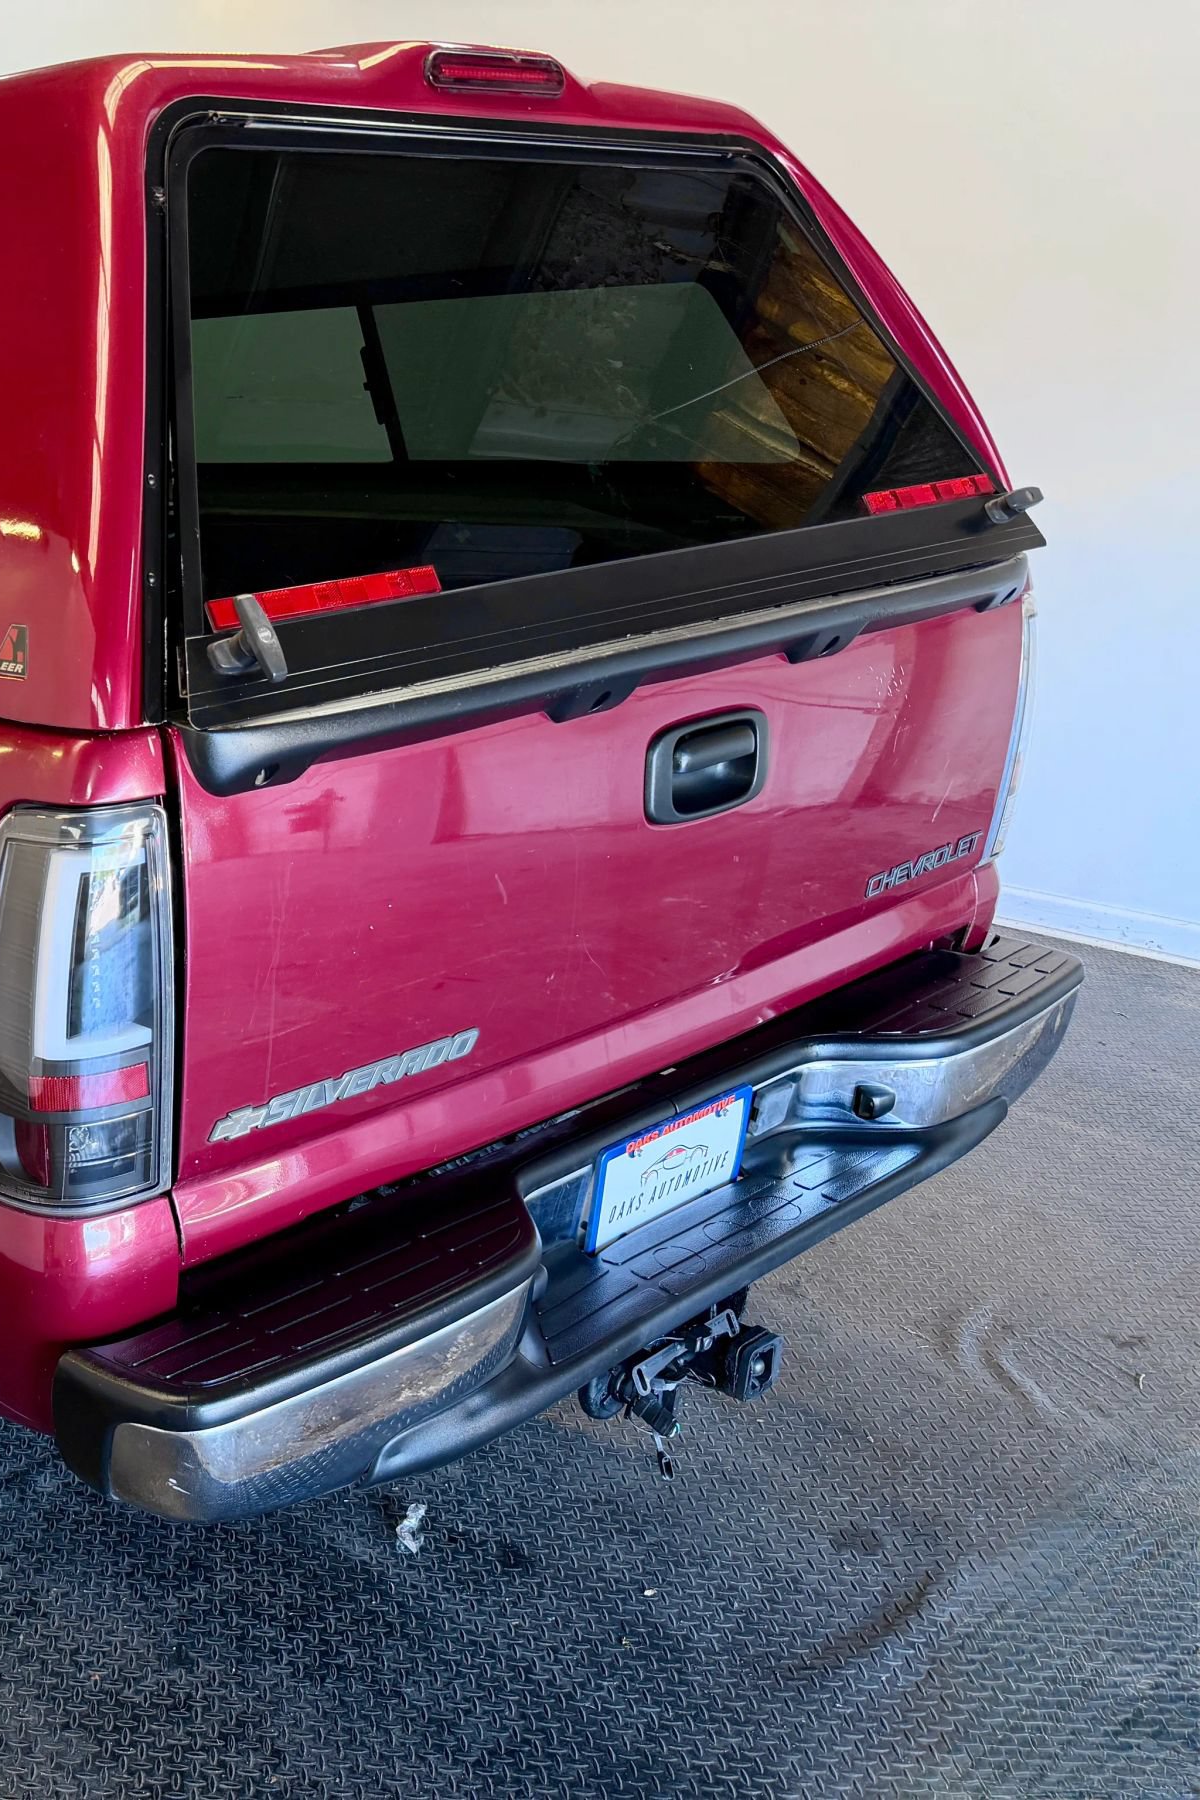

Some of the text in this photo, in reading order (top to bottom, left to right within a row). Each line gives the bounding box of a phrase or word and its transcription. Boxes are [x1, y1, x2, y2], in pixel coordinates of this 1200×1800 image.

[865, 830, 984, 898] CHEVROLET
[259, 1026, 480, 1129] SILVERADO
[626, 1095, 736, 1155] OAKS AUTOMOTIVE
[608, 1150, 729, 1224] OAKS AUTOMOTIVE
